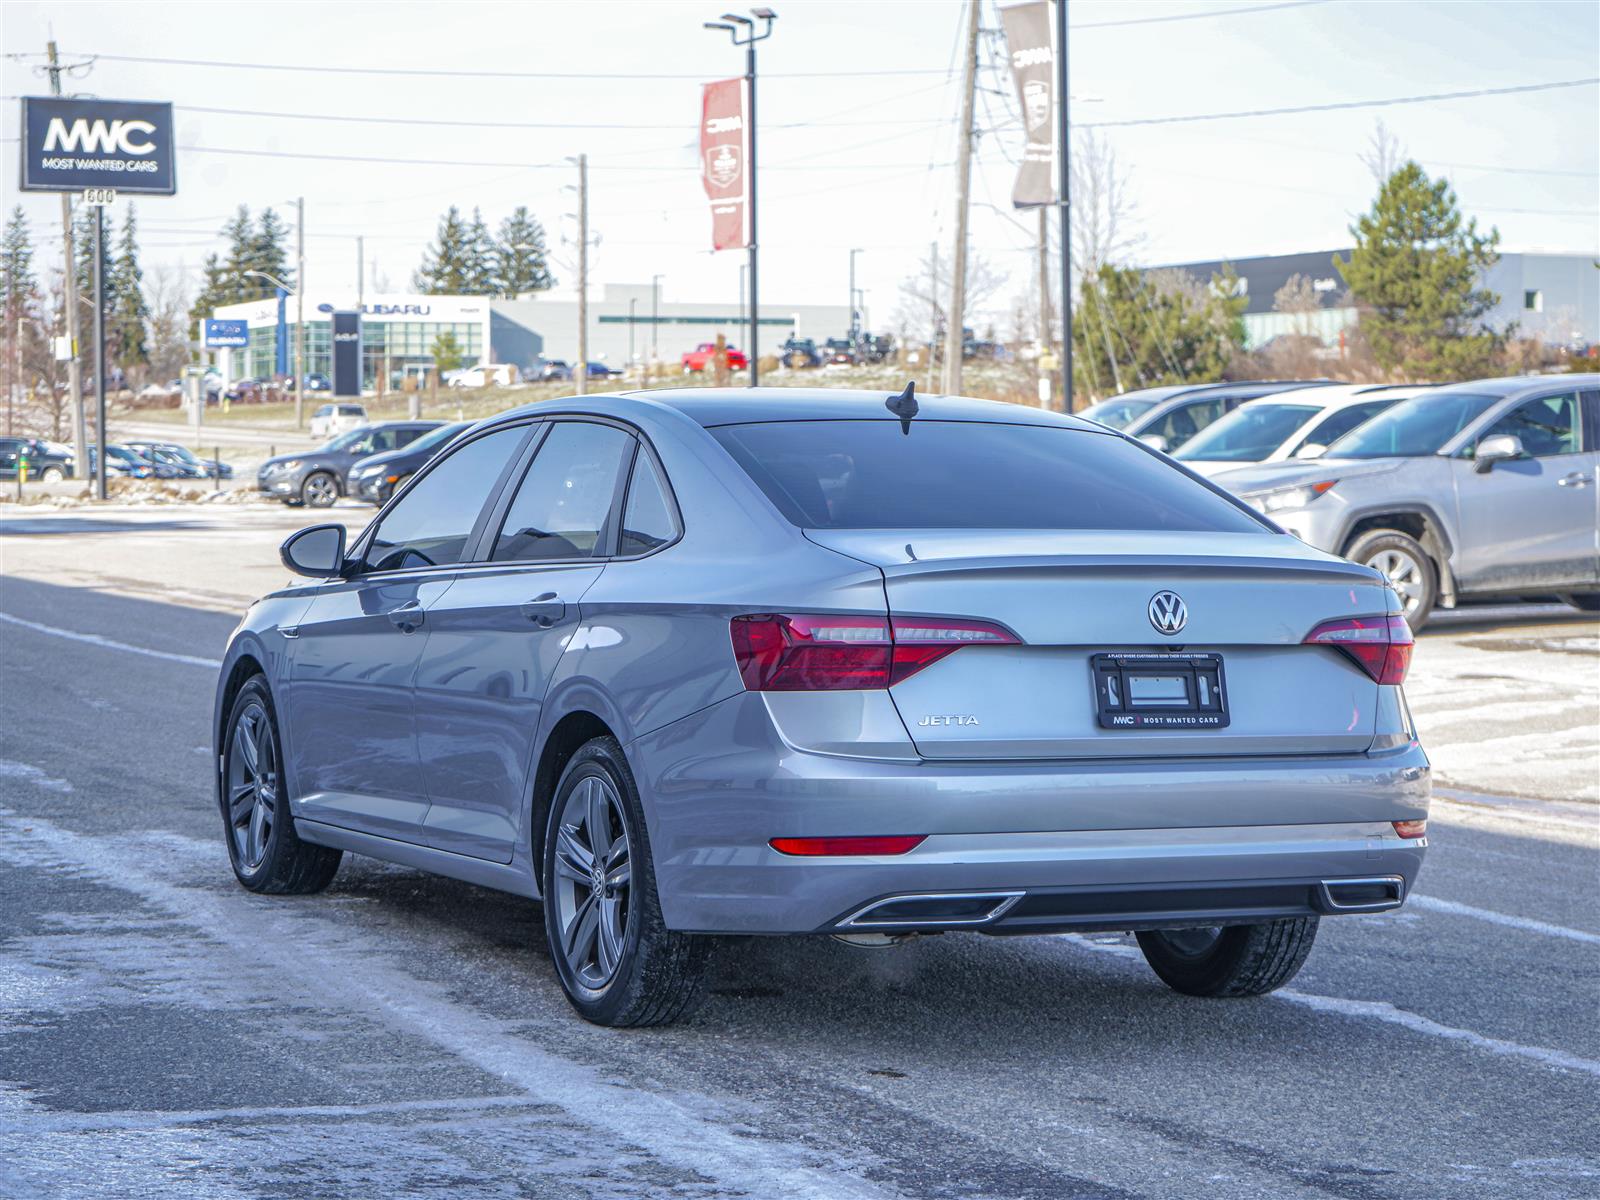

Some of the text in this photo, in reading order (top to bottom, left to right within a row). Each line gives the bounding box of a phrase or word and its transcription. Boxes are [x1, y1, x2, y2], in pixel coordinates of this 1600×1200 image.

[42, 117, 157, 155] MWC
[42, 158, 158, 172] MOST WANTED CARS
[361, 304, 430, 316] UBARU
[918, 714, 980, 726] JETTA
[1113, 716, 1134, 724] MWC
